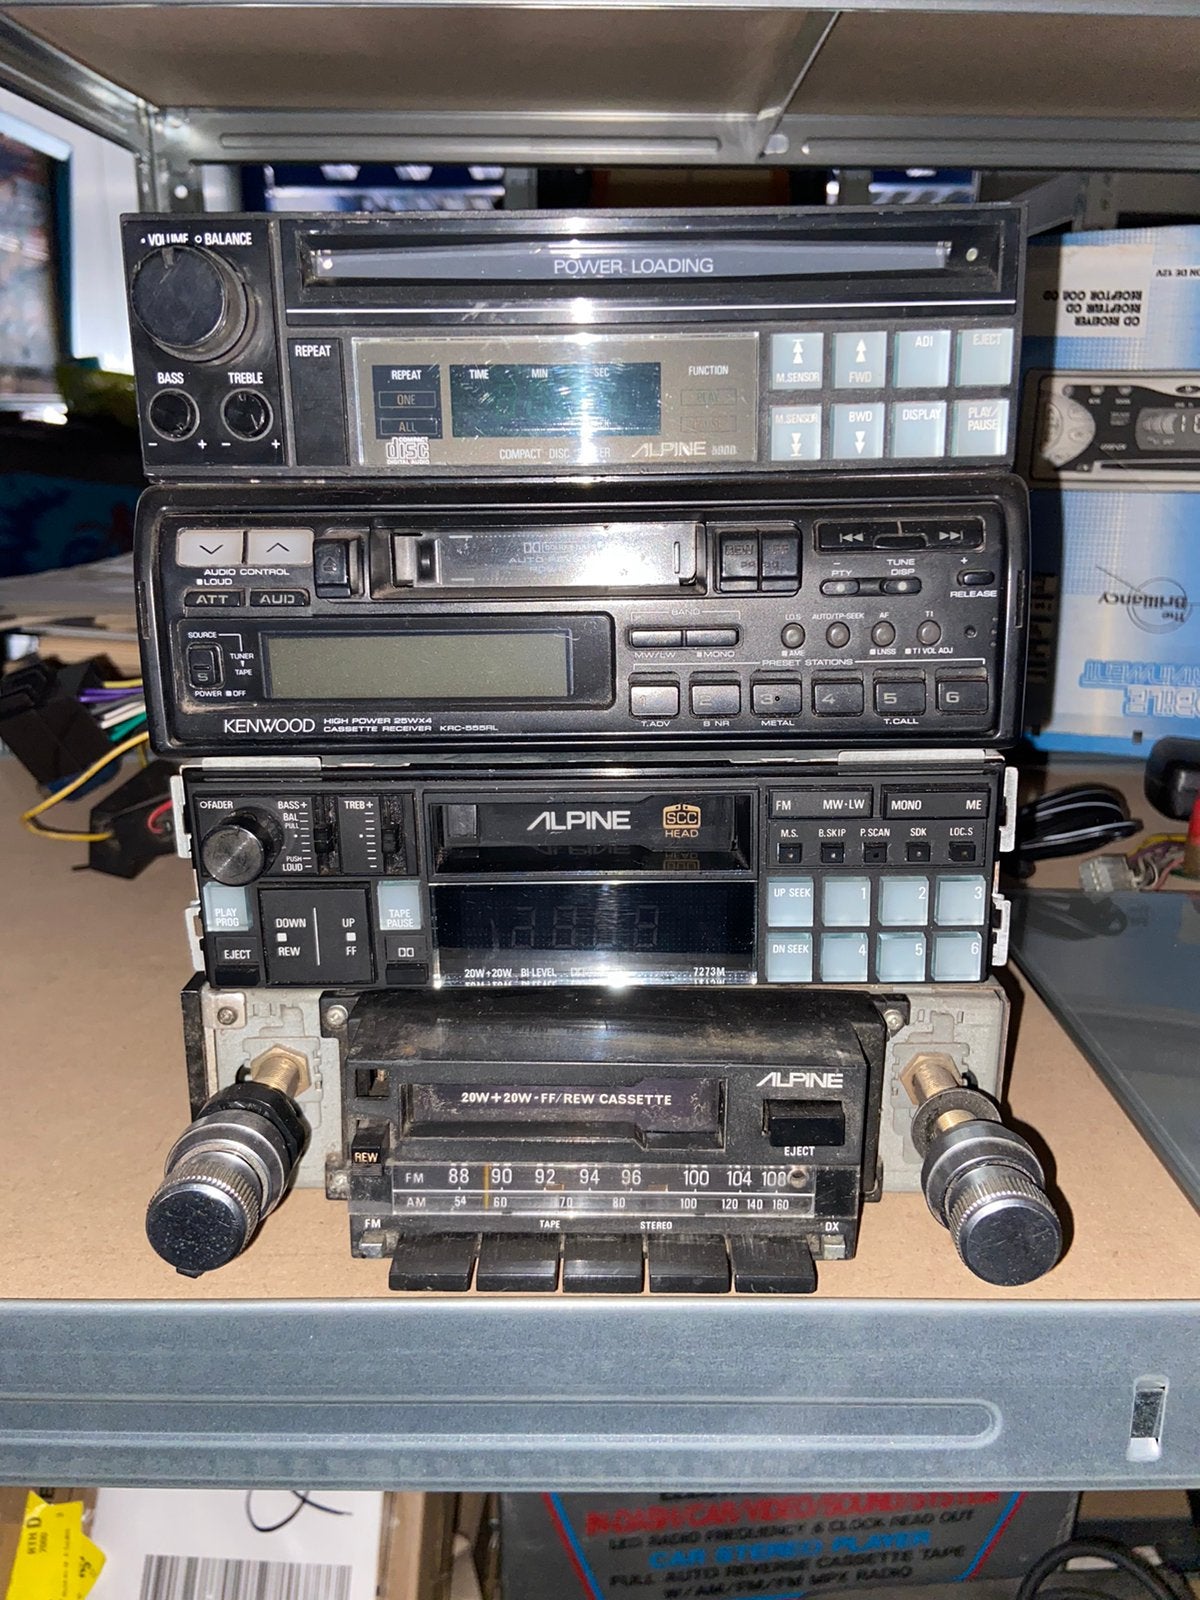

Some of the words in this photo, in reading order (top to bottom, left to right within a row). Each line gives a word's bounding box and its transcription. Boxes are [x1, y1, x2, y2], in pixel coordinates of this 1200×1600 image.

[148, 234, 188, 246] VOLUME
[204, 233, 252, 245] BALANCE
[554, 260, 622, 274] POWER
[632, 258, 713, 273] LOADING
[1124, 316, 1140, 326] CD
[973, 334, 1001, 345] EJECT
[295, 345, 331, 357] REPEAT
[391, 370, 421, 380] REPEAT
[470, 369, 489, 379] TIME
[532, 369, 548, 378] MIN
[594, 368, 609, 377] SEC
[689, 366, 728, 375] FUNCTION
[158, 373, 184, 384] BASS
[229, 373, 263, 384] TREBLE
[776, 372, 820, 382] M.SENSOR
[849, 372, 872, 382] FWD
[397, 395, 416, 405] ONE
[776, 414, 818, 423] M.SENSOR
[849, 411, 872, 421] BWD
[903, 409, 942, 420] DISPLAY
[399, 422, 417, 432] ALL
[968, 420, 998, 430] PAUSE
[500, 449, 541, 459] COMPACT
[549, 448, 569, 458] DISC
[632, 441, 706, 457] ALPINE
[196, 595, 227, 604] ATT
[805, 658, 853, 666] STATIONS
[822, 693, 836, 704] 4
[884, 693, 897, 704] 5
[946, 692, 959, 702] 6
[224, 719, 315, 733] KENWOOD
[208, 801, 233, 809] FADER
[776, 801, 791, 810] FM
[891, 800, 921, 810] MONO
[966, 800, 982, 810] ME
[283, 813, 298, 821] BAL
[527, 811, 631, 830] ALPINE
[666, 812, 697, 824] SCC
[665, 830, 698, 838] HEAD
[781, 829, 798, 837] M.S.
[819, 828, 846, 837] B.SKIP
[860, 828, 890, 836] P.SCAN
[910, 828, 927, 836] SDK
[950, 827, 973, 835] LOC.S
[283, 863, 303, 871] LOUD
[774, 889, 786, 897] UP
[789, 888, 811, 897] SEEK
[861, 888, 866, 900] 1
[919, 887, 926, 899] 2
[974, 887, 982, 899] 3
[215, 908, 237, 917] PLAY
[389, 909, 410, 917] TAPE
[216, 917, 239, 926] PROG
[276, 919, 306, 927] DOWN
[342, 918, 355, 927] UP
[387, 919, 413, 927] PAUSE
[278, 947, 300, 956] REW
[346, 946, 357, 955] FF
[788, 944, 808, 953] SEEK
[859, 944, 866, 955] 4
[915, 944, 923, 955] 5
[971, 943, 979, 954] 6
[224, 950, 251, 959] EJECT
[521, 968, 556, 977] BI-LEVEL
[693, 967, 726, 977] 7273M
[756, 1072, 843, 1088] ALPINE
[599, 1094, 672, 1105] CASSETTE
[784, 1146, 815, 1156] EJECT
[355, 1152, 378, 1162] REW
[405, 1173, 424, 1183] FM
[449, 1169, 469, 1183] 88
[492, 1169, 512, 1183] 90
[535, 1169, 555, 1184] 92
[580, 1170, 599, 1184] 94
[622, 1170, 641, 1184] 96
[684, 1170, 709, 1185] 100
[727, 1171, 752, 1186] 104
[407, 1198, 426, 1207] AM
[454, 1197, 466, 1206] 54
[493, 1198, 507, 1207] 60
[559, 1197, 572, 1207] 70
[613, 1198, 625, 1207] 80
[680, 1198, 697, 1209] 100
[722, 1199, 738, 1209] 120
[747, 1199, 763, 1209] 140
[773, 1200, 789, 1210] 160
[364, 1219, 381, 1227] FM
[540, 1220, 560, 1228] TAPE
[640, 1221, 672, 1229] STEREO
[825, 1222, 839, 1230] DX
[648, 1548, 706, 1569] CAR
[831, 1529, 932, 1553] PLAYER
